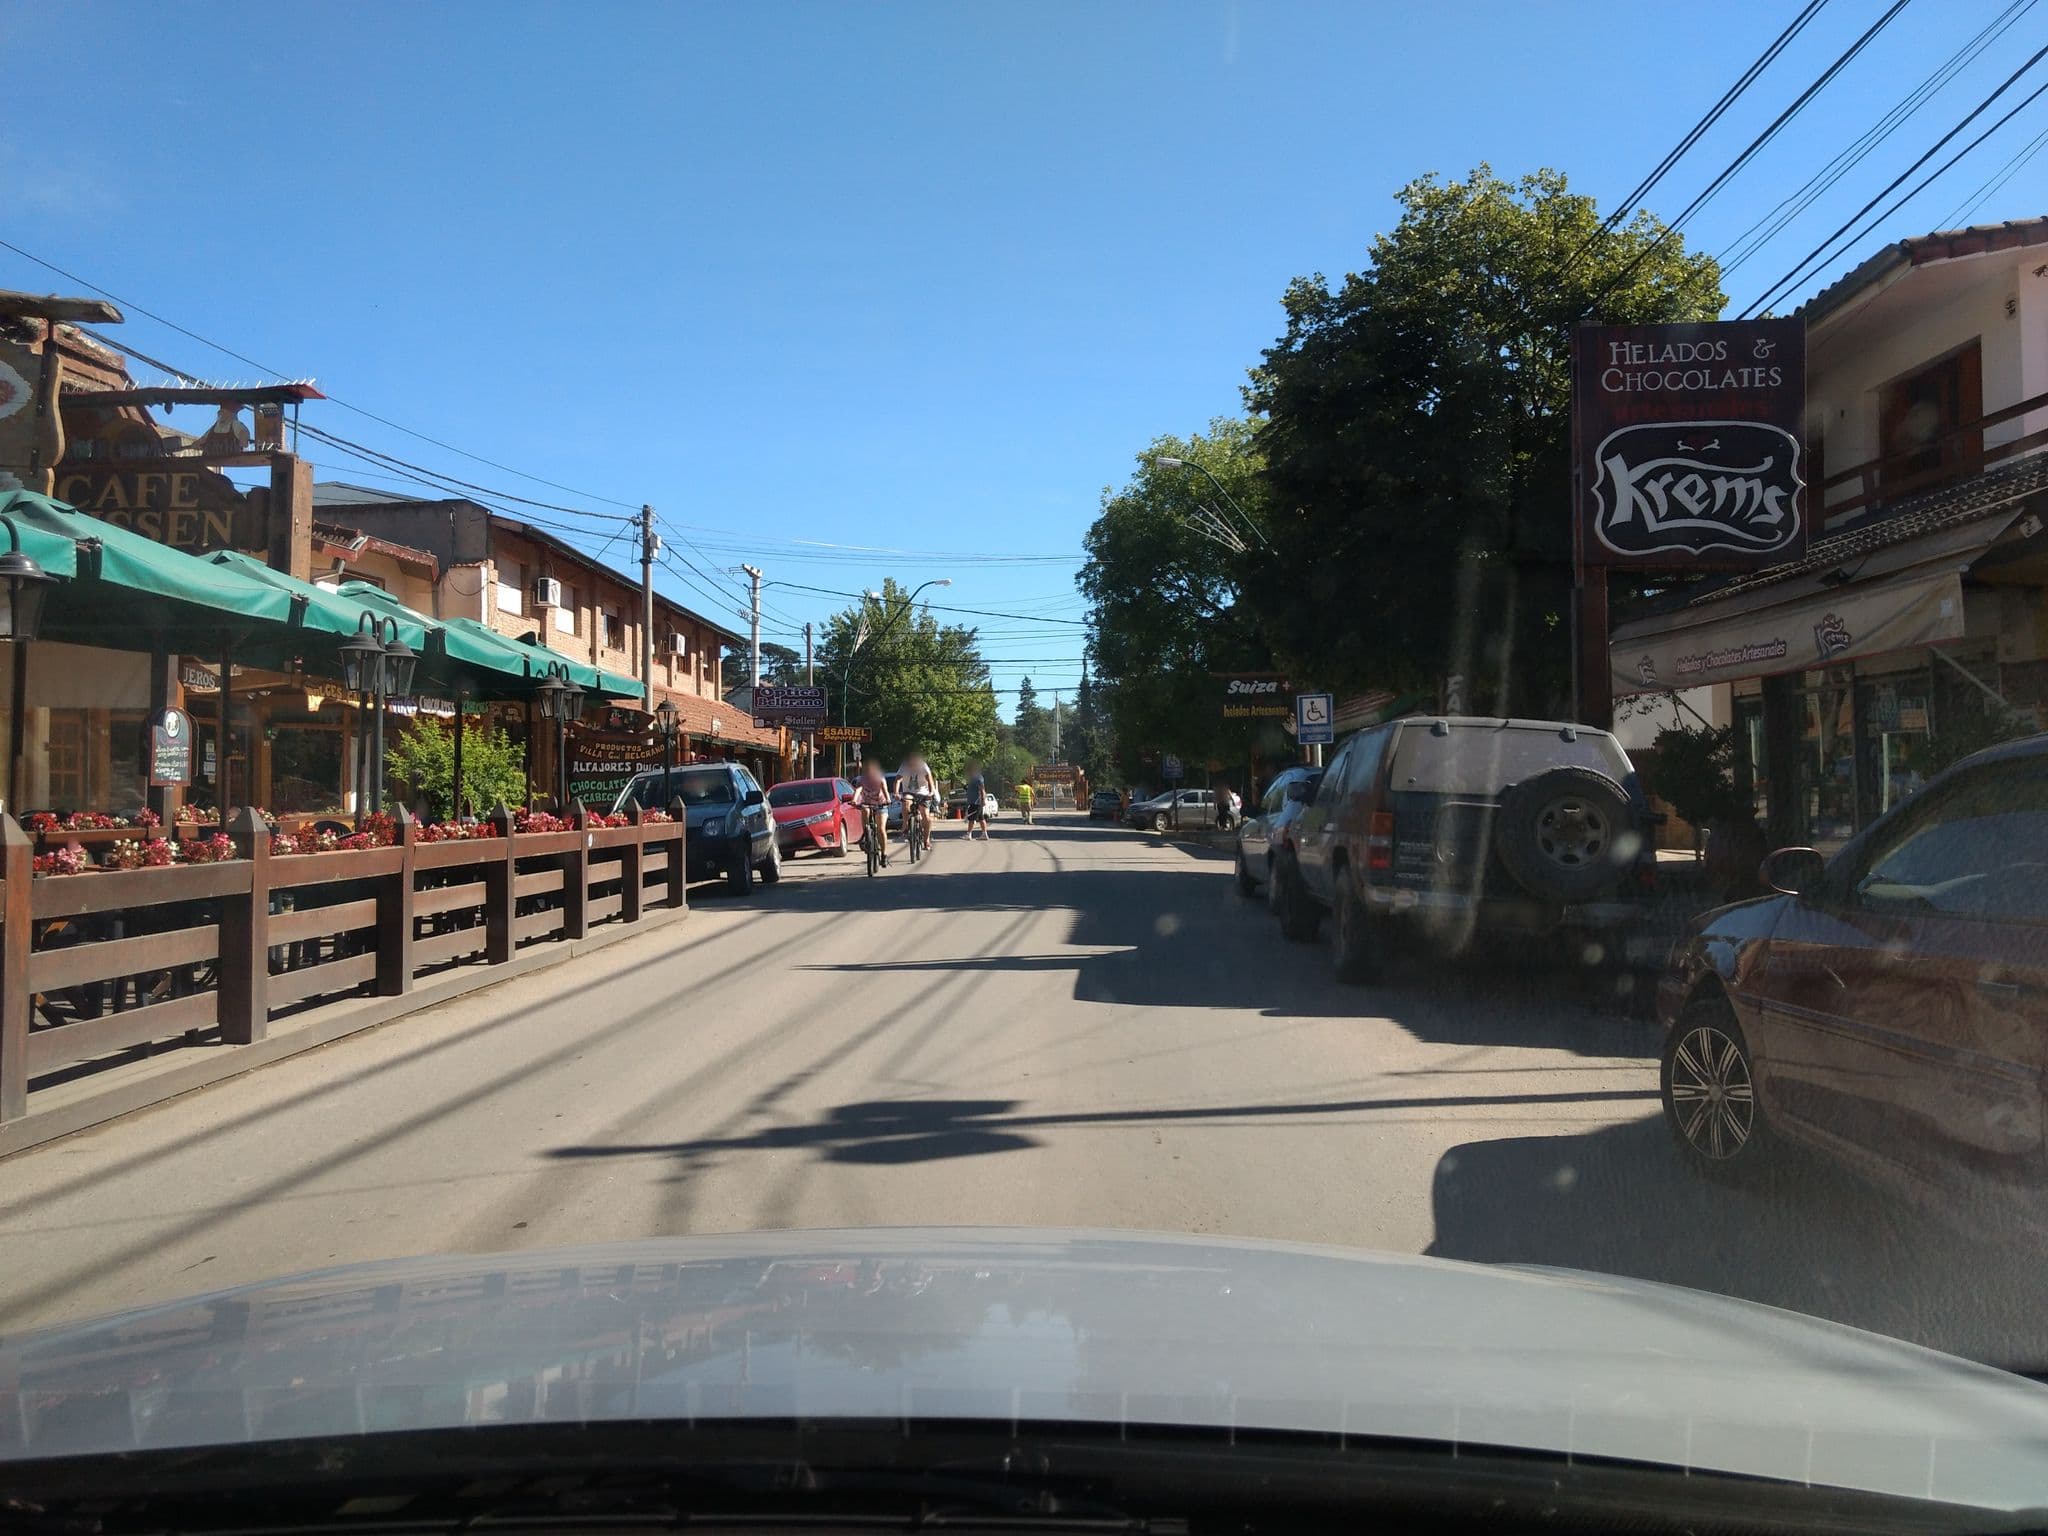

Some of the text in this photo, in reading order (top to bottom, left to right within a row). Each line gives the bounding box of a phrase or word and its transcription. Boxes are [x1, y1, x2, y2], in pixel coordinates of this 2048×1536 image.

[1608, 338, 1777, 366] HELADOS &
[1601, 366, 1782, 392] CHOCOLATES
[58, 472, 200, 509] CAFE
[1603, 453, 1789, 543] Krems
[1227, 680, 1278, 694] Suiza
[757, 697, 823, 709] Belgrano
[580, 745, 602, 758] VILLA
[625, 744, 665, 760] BELGRANO
[595, 743, 641, 752] PRODUCTOS
[573, 761, 631, 773] ALFAJORES
